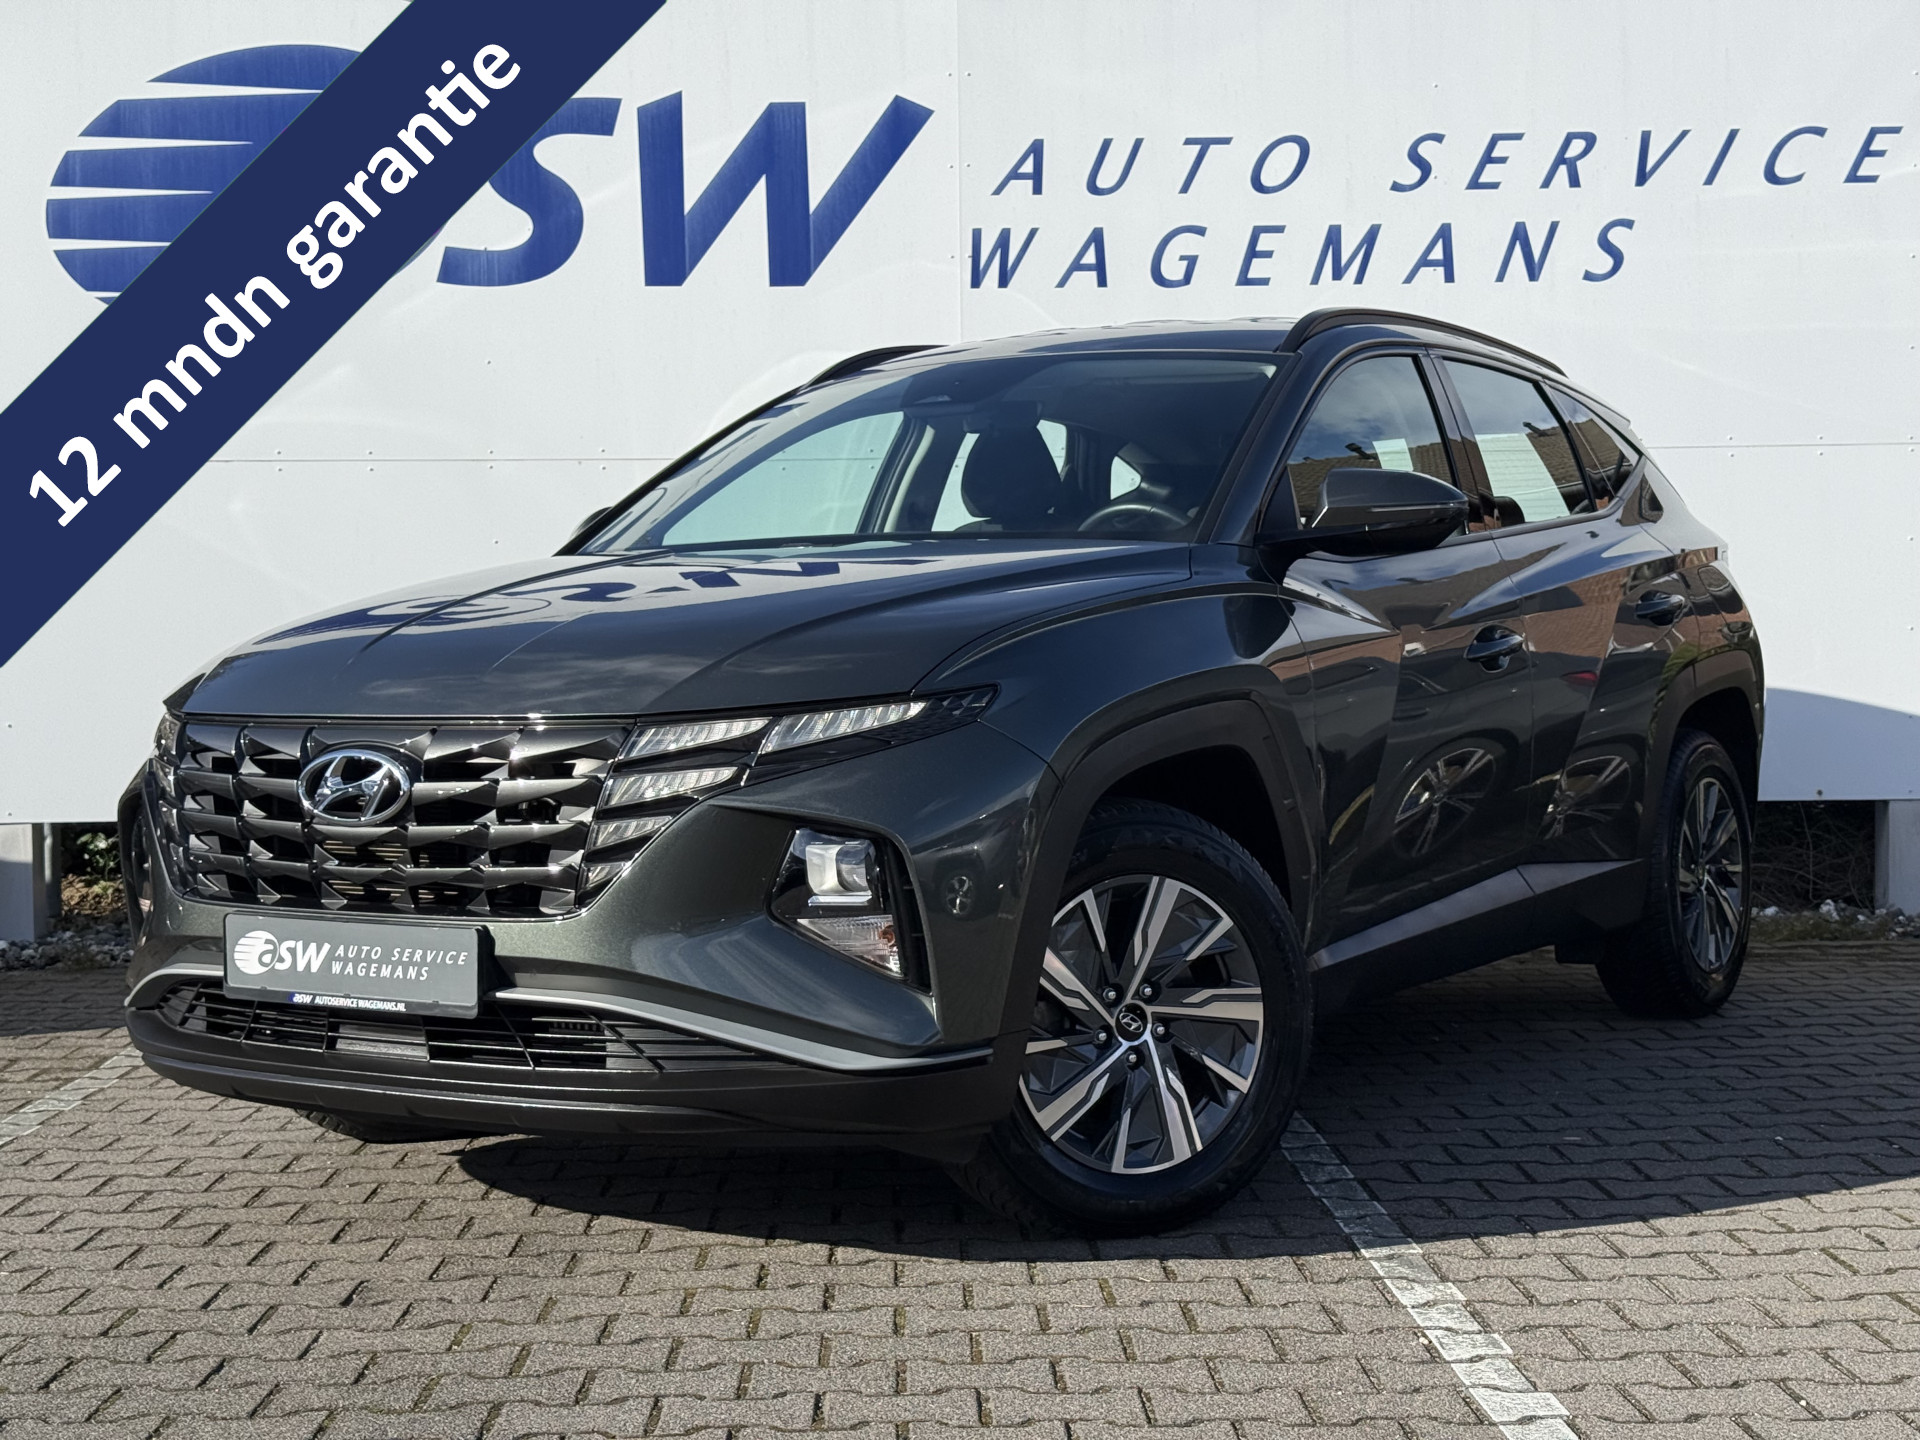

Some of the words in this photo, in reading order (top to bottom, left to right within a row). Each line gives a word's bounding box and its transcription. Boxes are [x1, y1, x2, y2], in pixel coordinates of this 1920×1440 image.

[991, 134, 1312, 197] AUTO
[1390, 125, 1903, 193] SERVICE
[969, 218, 1636, 289] WAGEMANS
[334, 944, 382, 960] AUTO
[391, 947, 469, 966] SERVICE
[331, 960, 429, 981] WAGEMANS
[314, 995, 358, 1008] AUTOSERVICE
[358, 999, 407, 1012] WAGEMANS.NL
